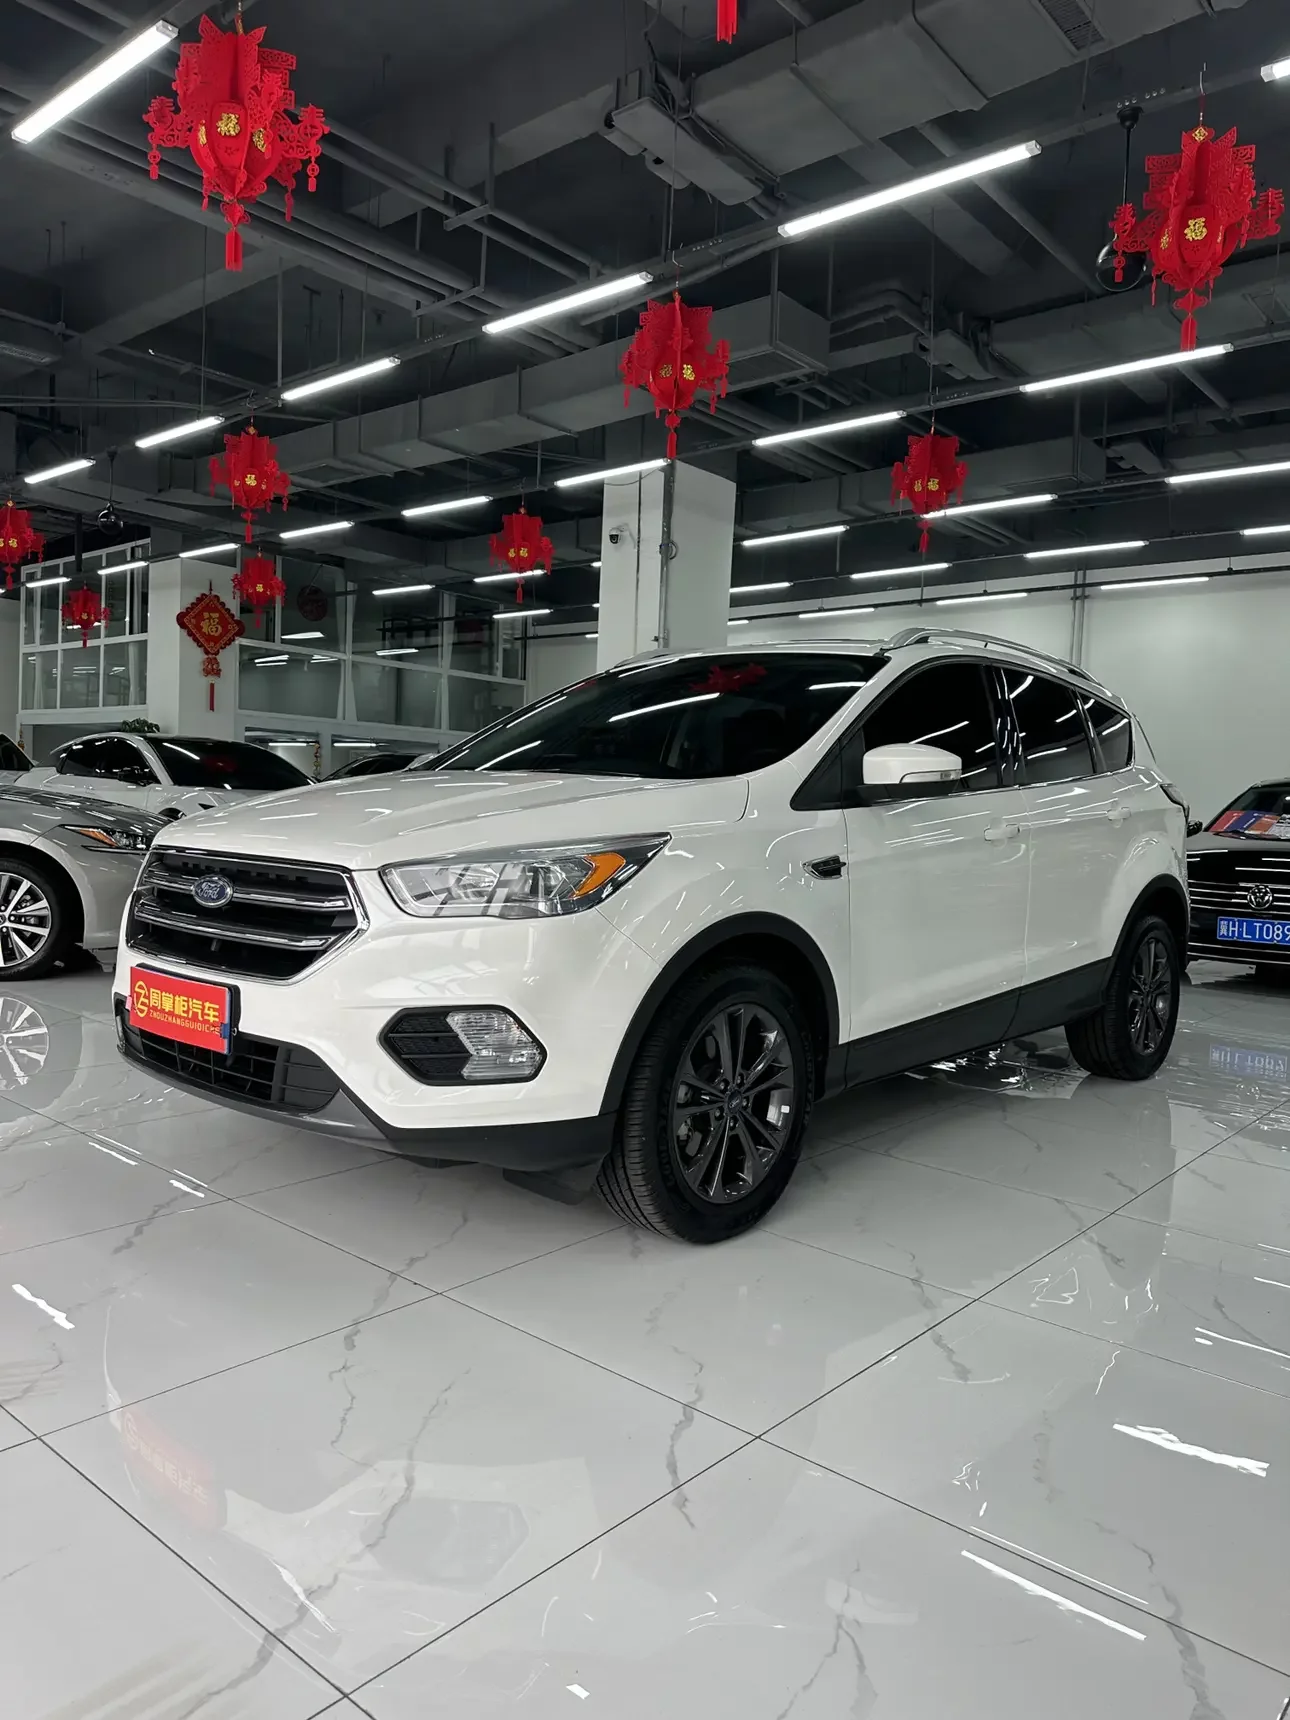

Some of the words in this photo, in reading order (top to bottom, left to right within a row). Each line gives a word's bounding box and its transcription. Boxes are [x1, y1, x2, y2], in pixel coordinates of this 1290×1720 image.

[216, 113, 240, 136] 福
[1184, 217, 1208, 241] 福
[200, 612, 222, 637] 福
[197, 882, 220, 899] Ford
[149, 987, 220, 1023] 周掌柜汽车
